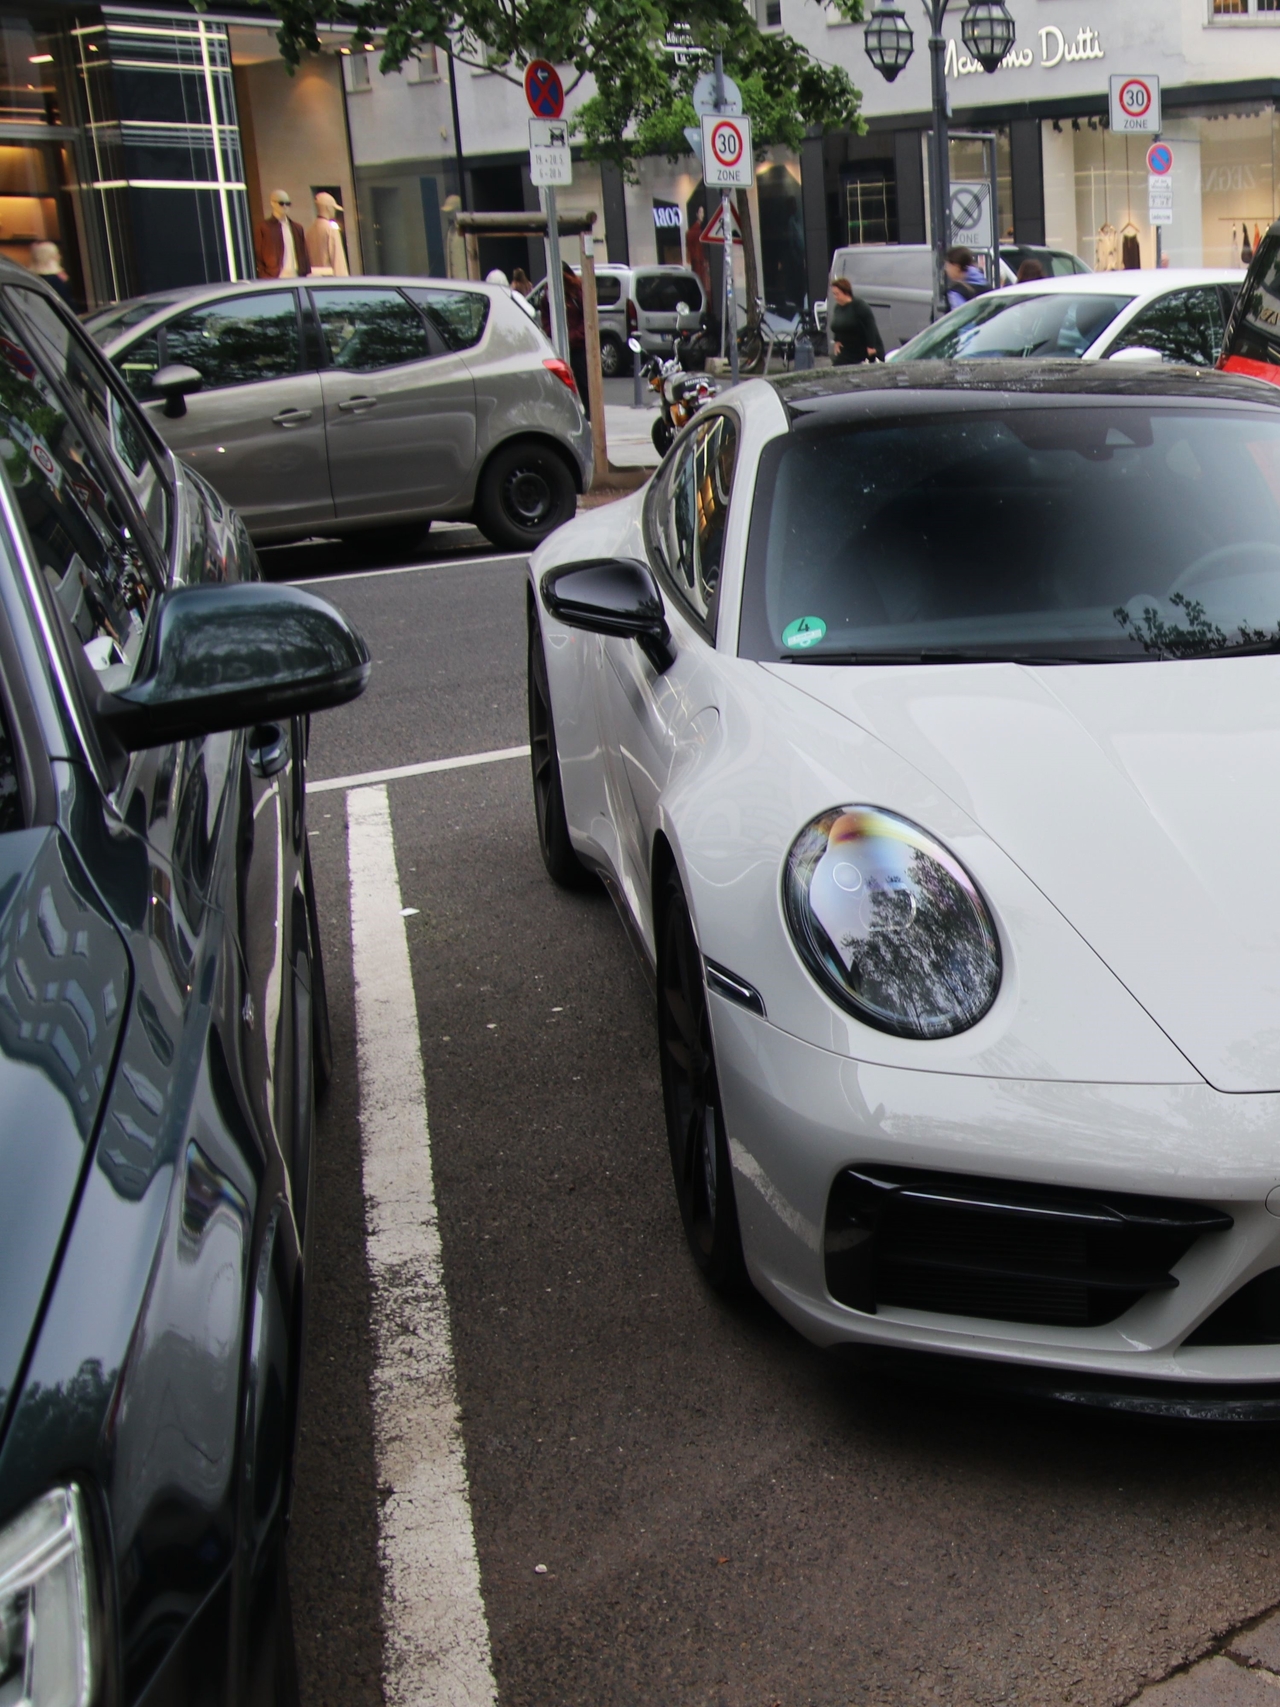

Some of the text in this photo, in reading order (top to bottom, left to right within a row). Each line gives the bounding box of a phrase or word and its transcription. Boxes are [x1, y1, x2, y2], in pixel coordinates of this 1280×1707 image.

[1038, 25, 1104, 68] Dutti
[1126, 89, 1145, 107] 30
[1123, 119, 1148, 129] ZONE
[718, 133, 737, 154] 30
[717, 169, 740, 181] ZONE
[797, 618, 810, 632] 4
